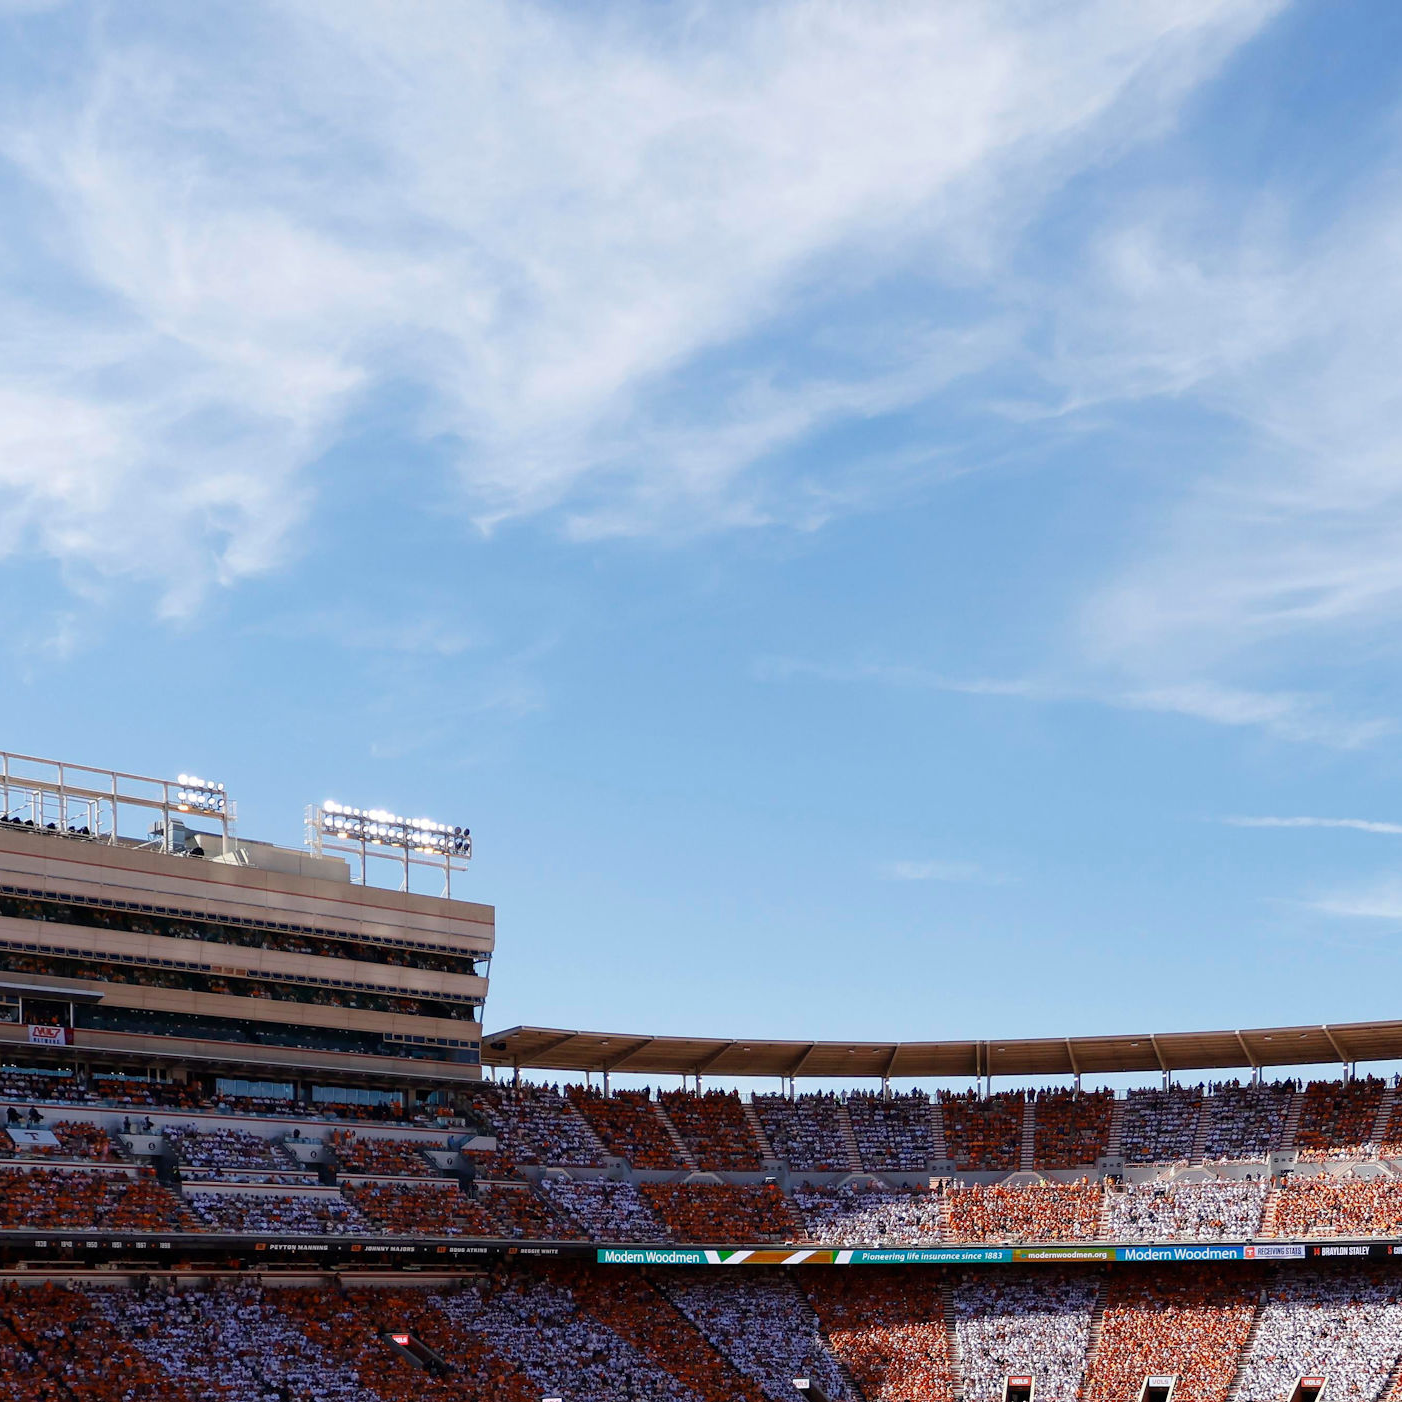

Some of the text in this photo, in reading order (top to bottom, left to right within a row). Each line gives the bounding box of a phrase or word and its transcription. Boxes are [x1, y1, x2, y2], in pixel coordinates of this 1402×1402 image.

[1028, 1251, 1108, 1260] modernwoodmen.org
[1125, 1248, 1237, 1260] Modern Woodmen
[1257, 1247, 1284, 1255] RECEIVING
[1321, 1247, 1348, 1256] BRAYLON
[1350, 1246, 1370, 1255] STALEY
[604, 1250, 700, 1263] Modern Woodmen
[862, 1252, 905, 1261] Pioneering
[906, 1252, 920, 1260] life
[921, 1252, 957, 1260] insurance
[958, 1252, 982, 1260] since
